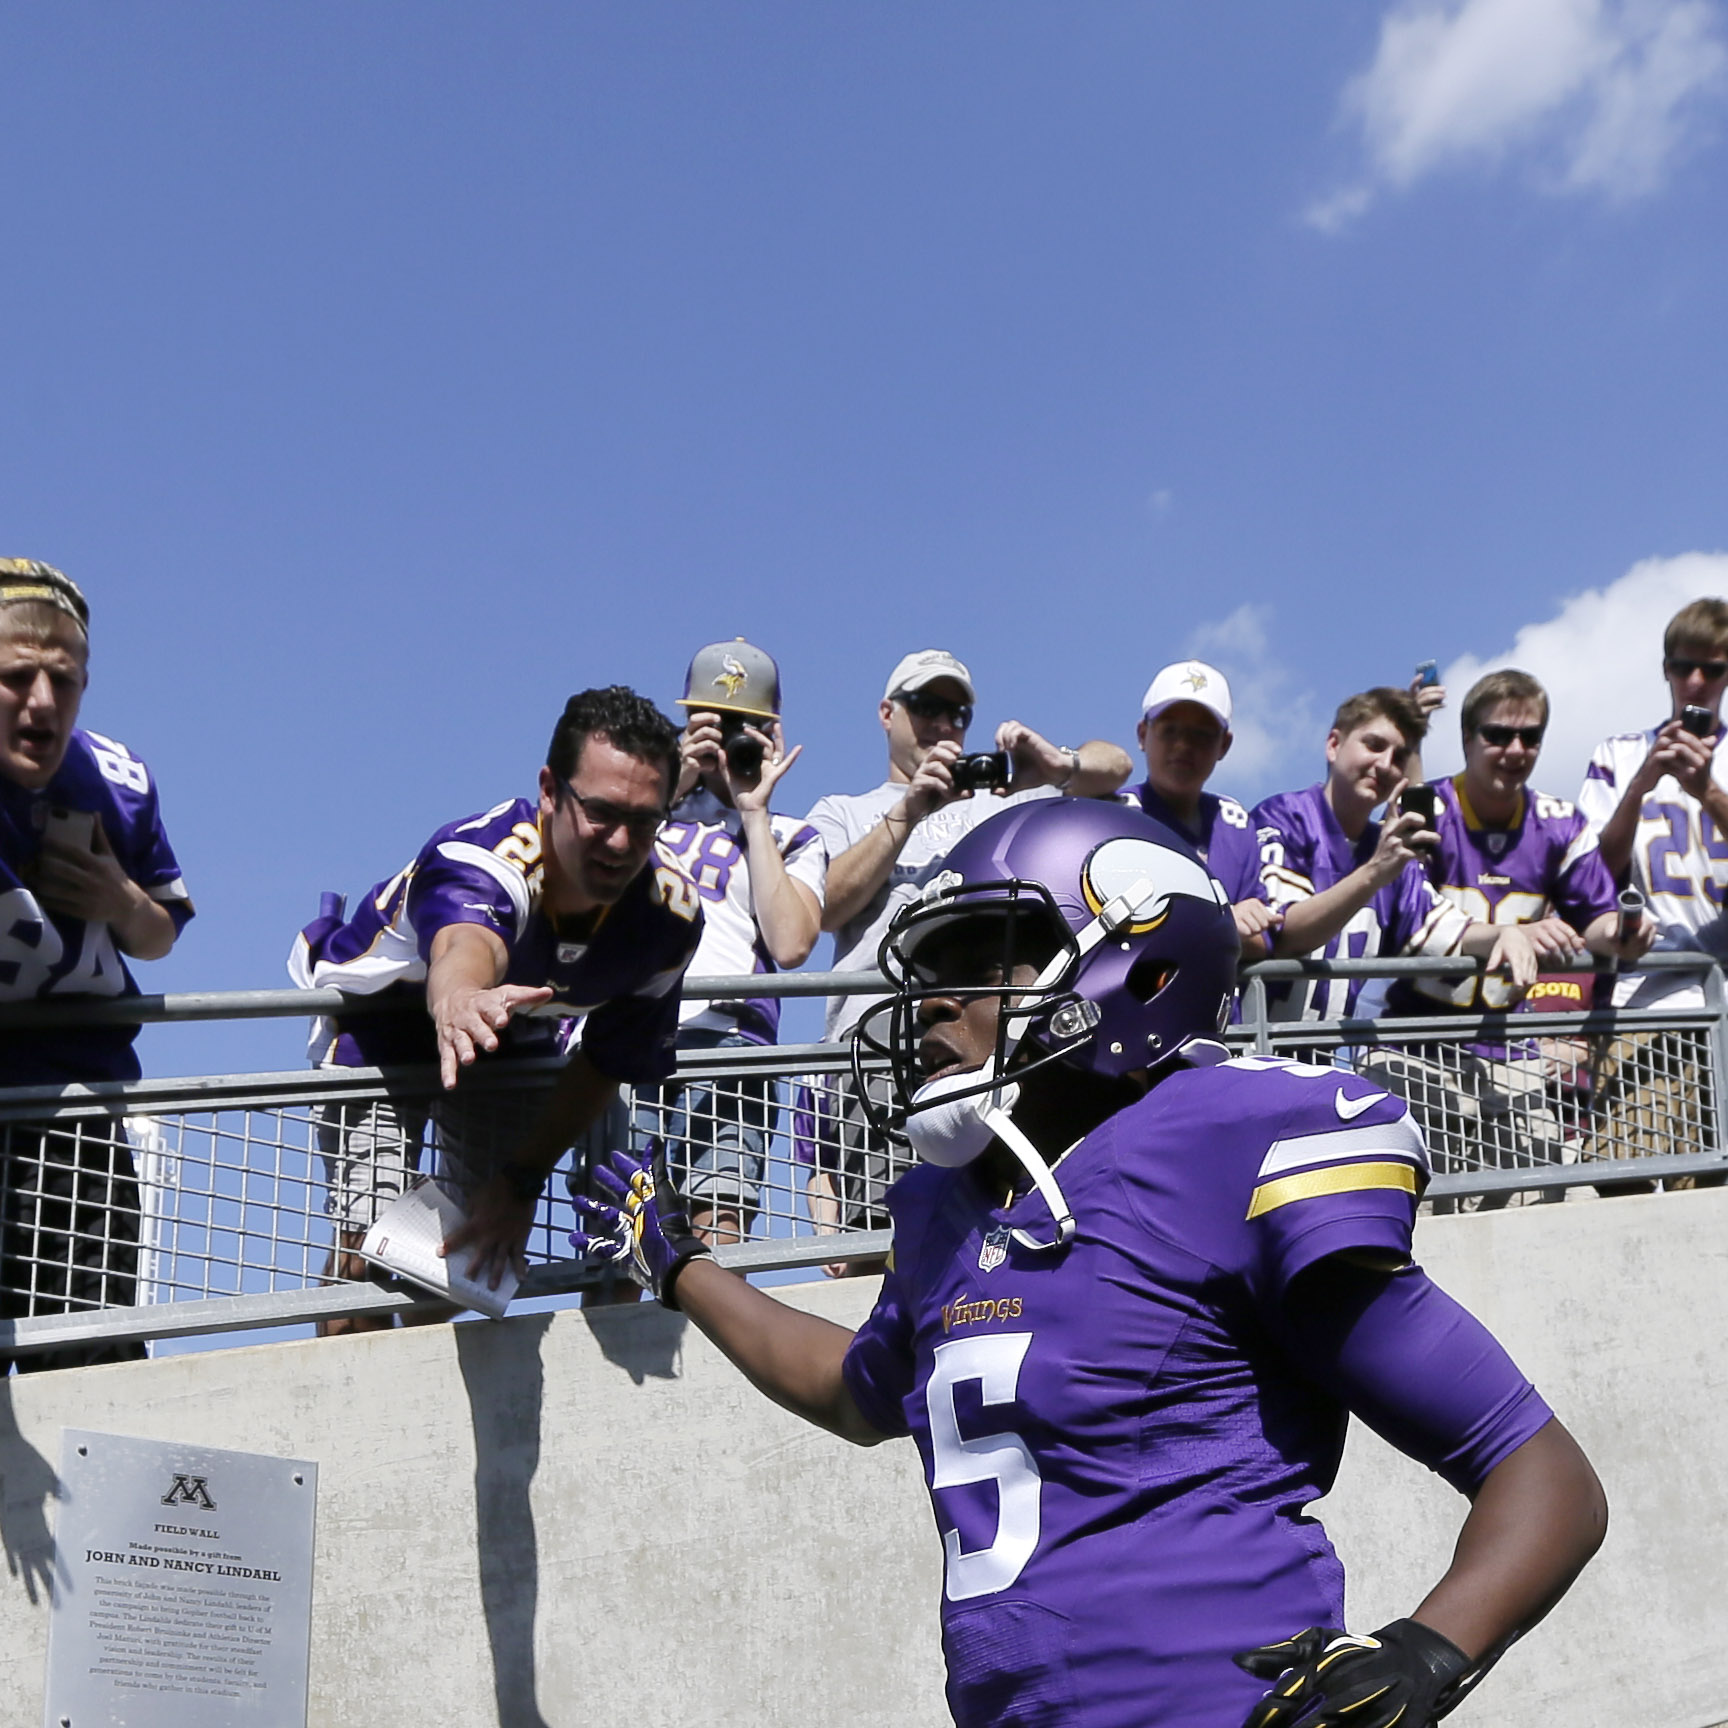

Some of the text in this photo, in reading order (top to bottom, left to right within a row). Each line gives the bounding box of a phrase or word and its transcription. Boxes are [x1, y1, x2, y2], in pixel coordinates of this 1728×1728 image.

[941, 1292, 1023, 1334] VIKINGS
[924, 1332, 1042, 1602] 5
[154, 1523, 220, 1539] FIELD WALL
[85, 1550, 282, 1582] JOHN AND NANCY LINDAHL
[129, 1542, 152, 1551] Made
[154, 1545, 187, 1556] possible
[189, 1549, 200, 1557] by
[207, 1552, 221, 1561] gift
[222, 1554, 242, 1562] from
